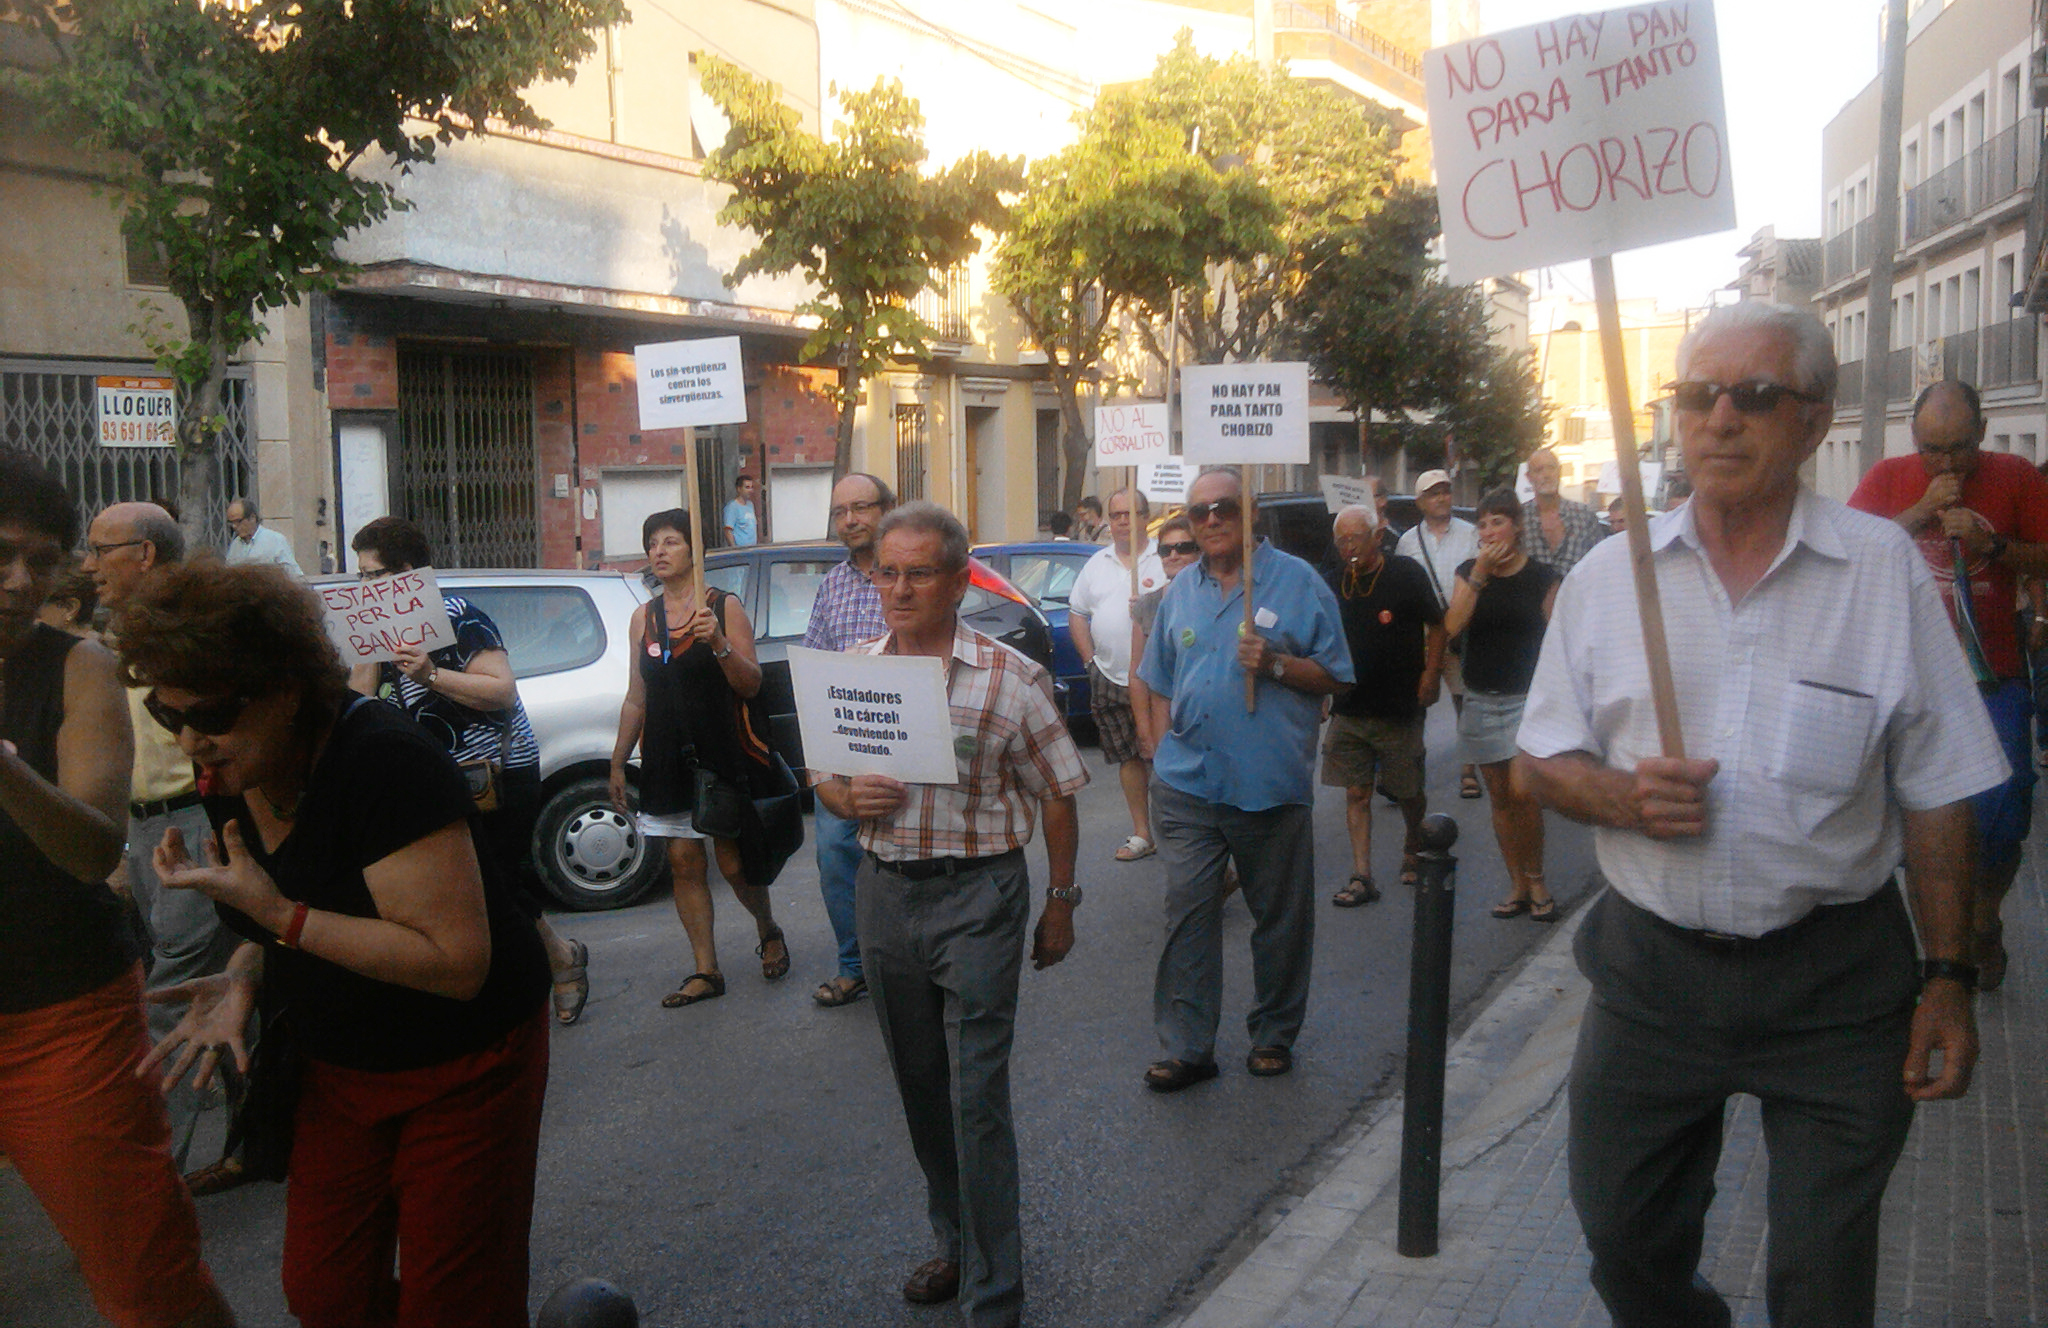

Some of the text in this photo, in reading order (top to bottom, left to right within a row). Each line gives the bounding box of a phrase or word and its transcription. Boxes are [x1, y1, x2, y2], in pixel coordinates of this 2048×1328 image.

[1443, 4, 1690, 99] NO HAY PAN
[1466, 38, 1698, 151] PARA TANTO
[1462, 121, 1721, 240] CHORIZO
[650, 367, 665, 379] Los
[667, 377, 712, 390] contra los
[1211, 383, 1281, 398] NO HAY PAN
[102, 395, 172, 416] LLOGUER
[1210, 403, 1283, 417] PARA TANTO
[1099, 406, 1154, 434] NO AL
[1221, 423, 1274, 437] CHORIZO
[102, 421, 117, 441] 93
[120, 421, 142, 441] 691
[1099, 431, 1164, 455] CORRALITO
[322, 573, 425, 611] ESTAFATS
[346, 596, 425, 631] PER LA
[348, 621, 439, 656] BANCA
[827, 685, 903, 705] ¡Estafadores
[833, 706, 901, 724] a la cárcel!
[897, 729, 908, 741] lo
